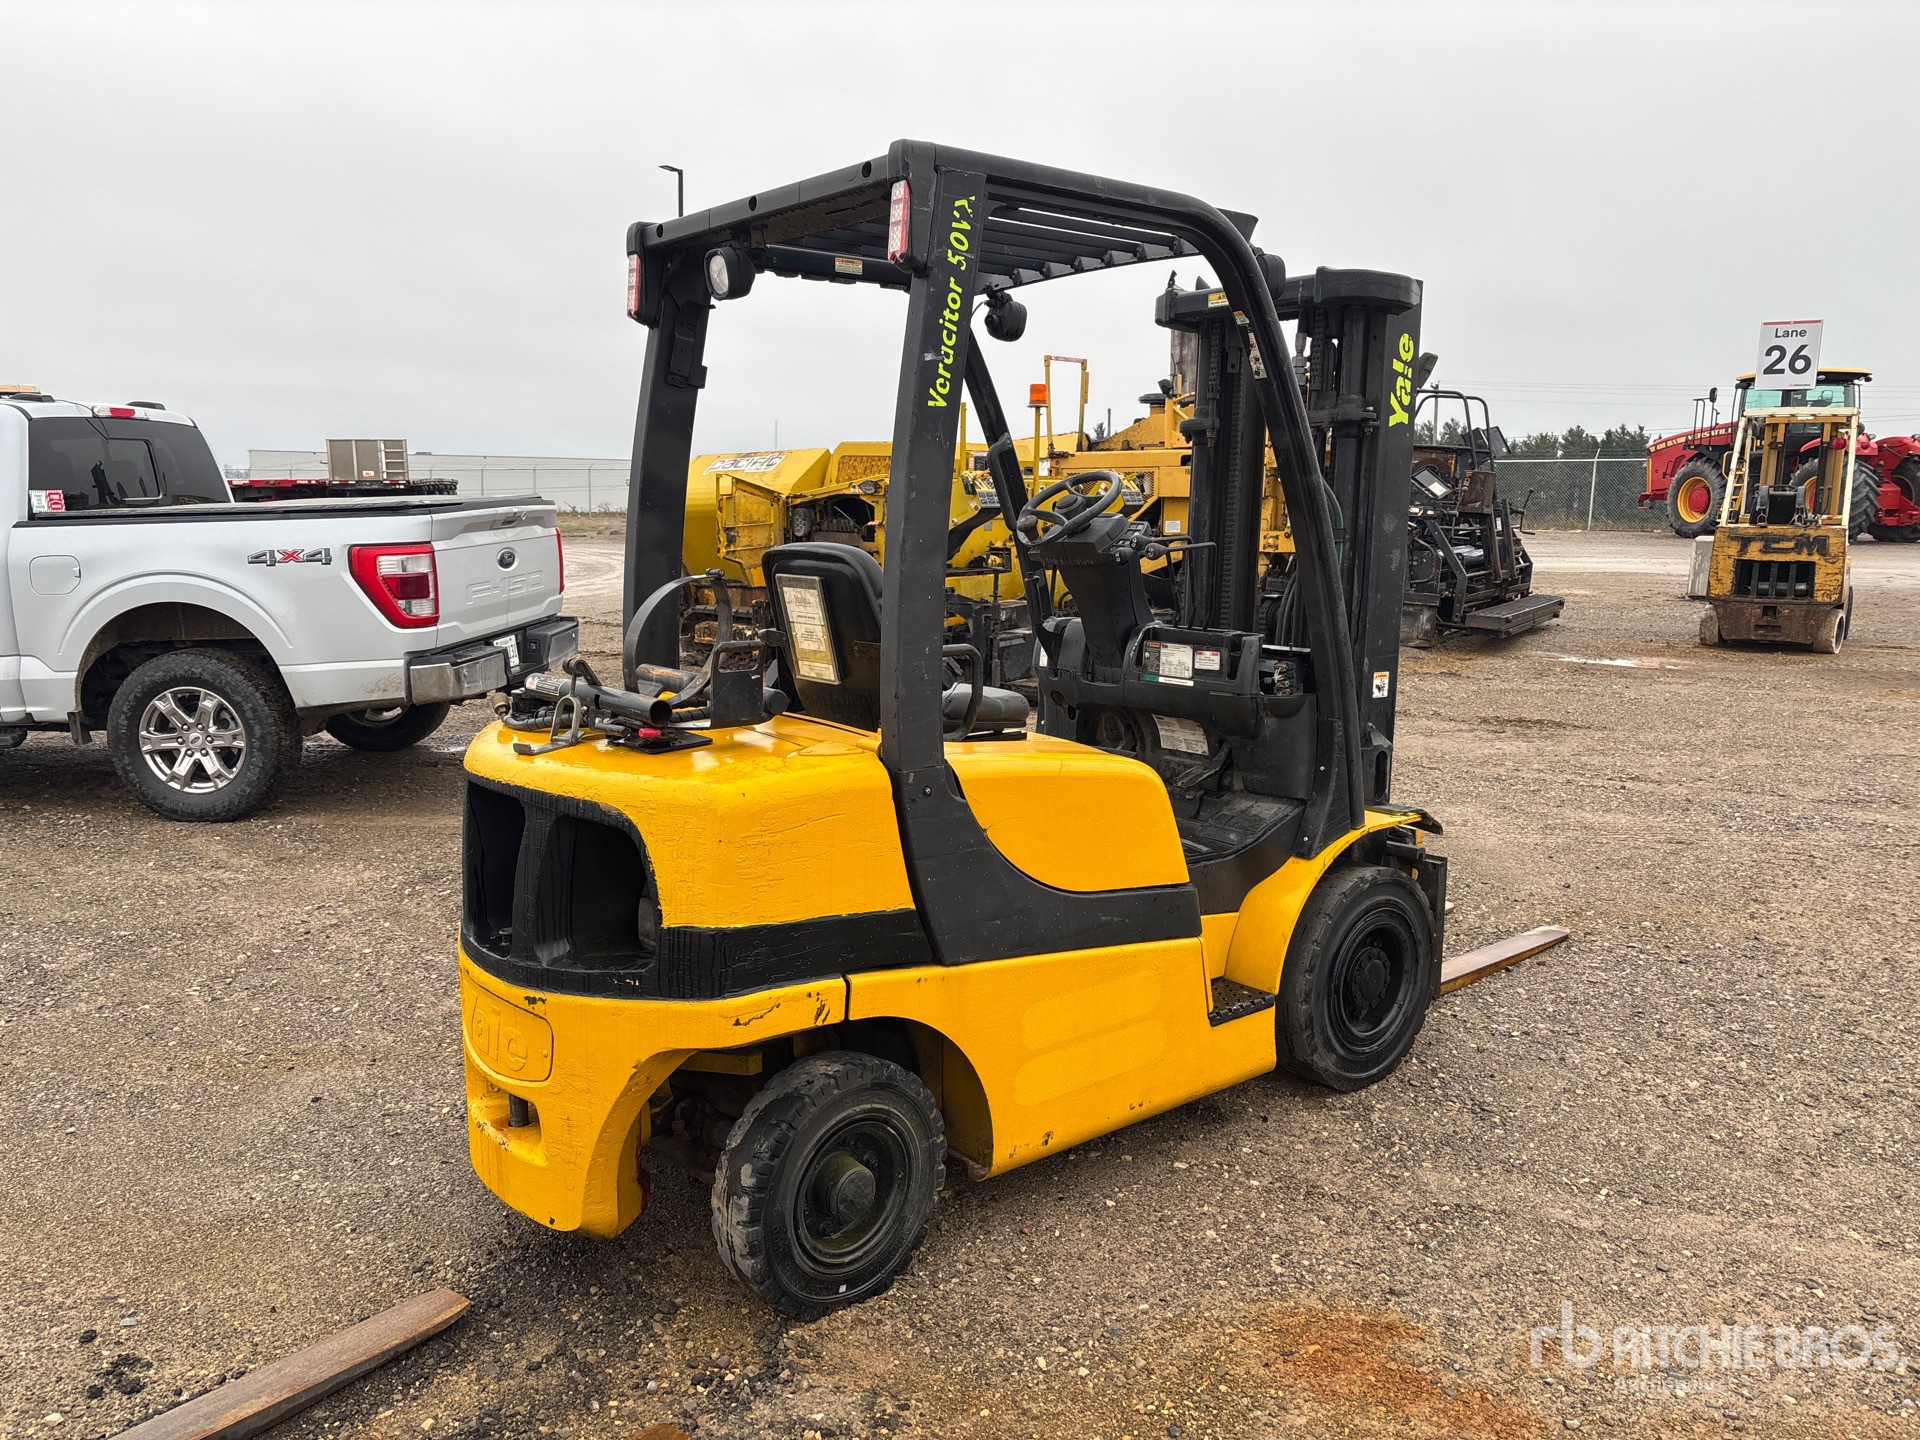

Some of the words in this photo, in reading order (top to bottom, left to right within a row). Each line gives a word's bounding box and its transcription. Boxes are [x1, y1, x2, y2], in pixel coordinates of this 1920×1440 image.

[928, 276, 963, 407] Veracitor
[1774, 327, 1808, 339] Lane
[1762, 344, 1812, 375] 26
[1389, 333, 1415, 427] Yale
[1728, 533, 1830, 557] TCM
[465, 569, 545, 606] F-150
